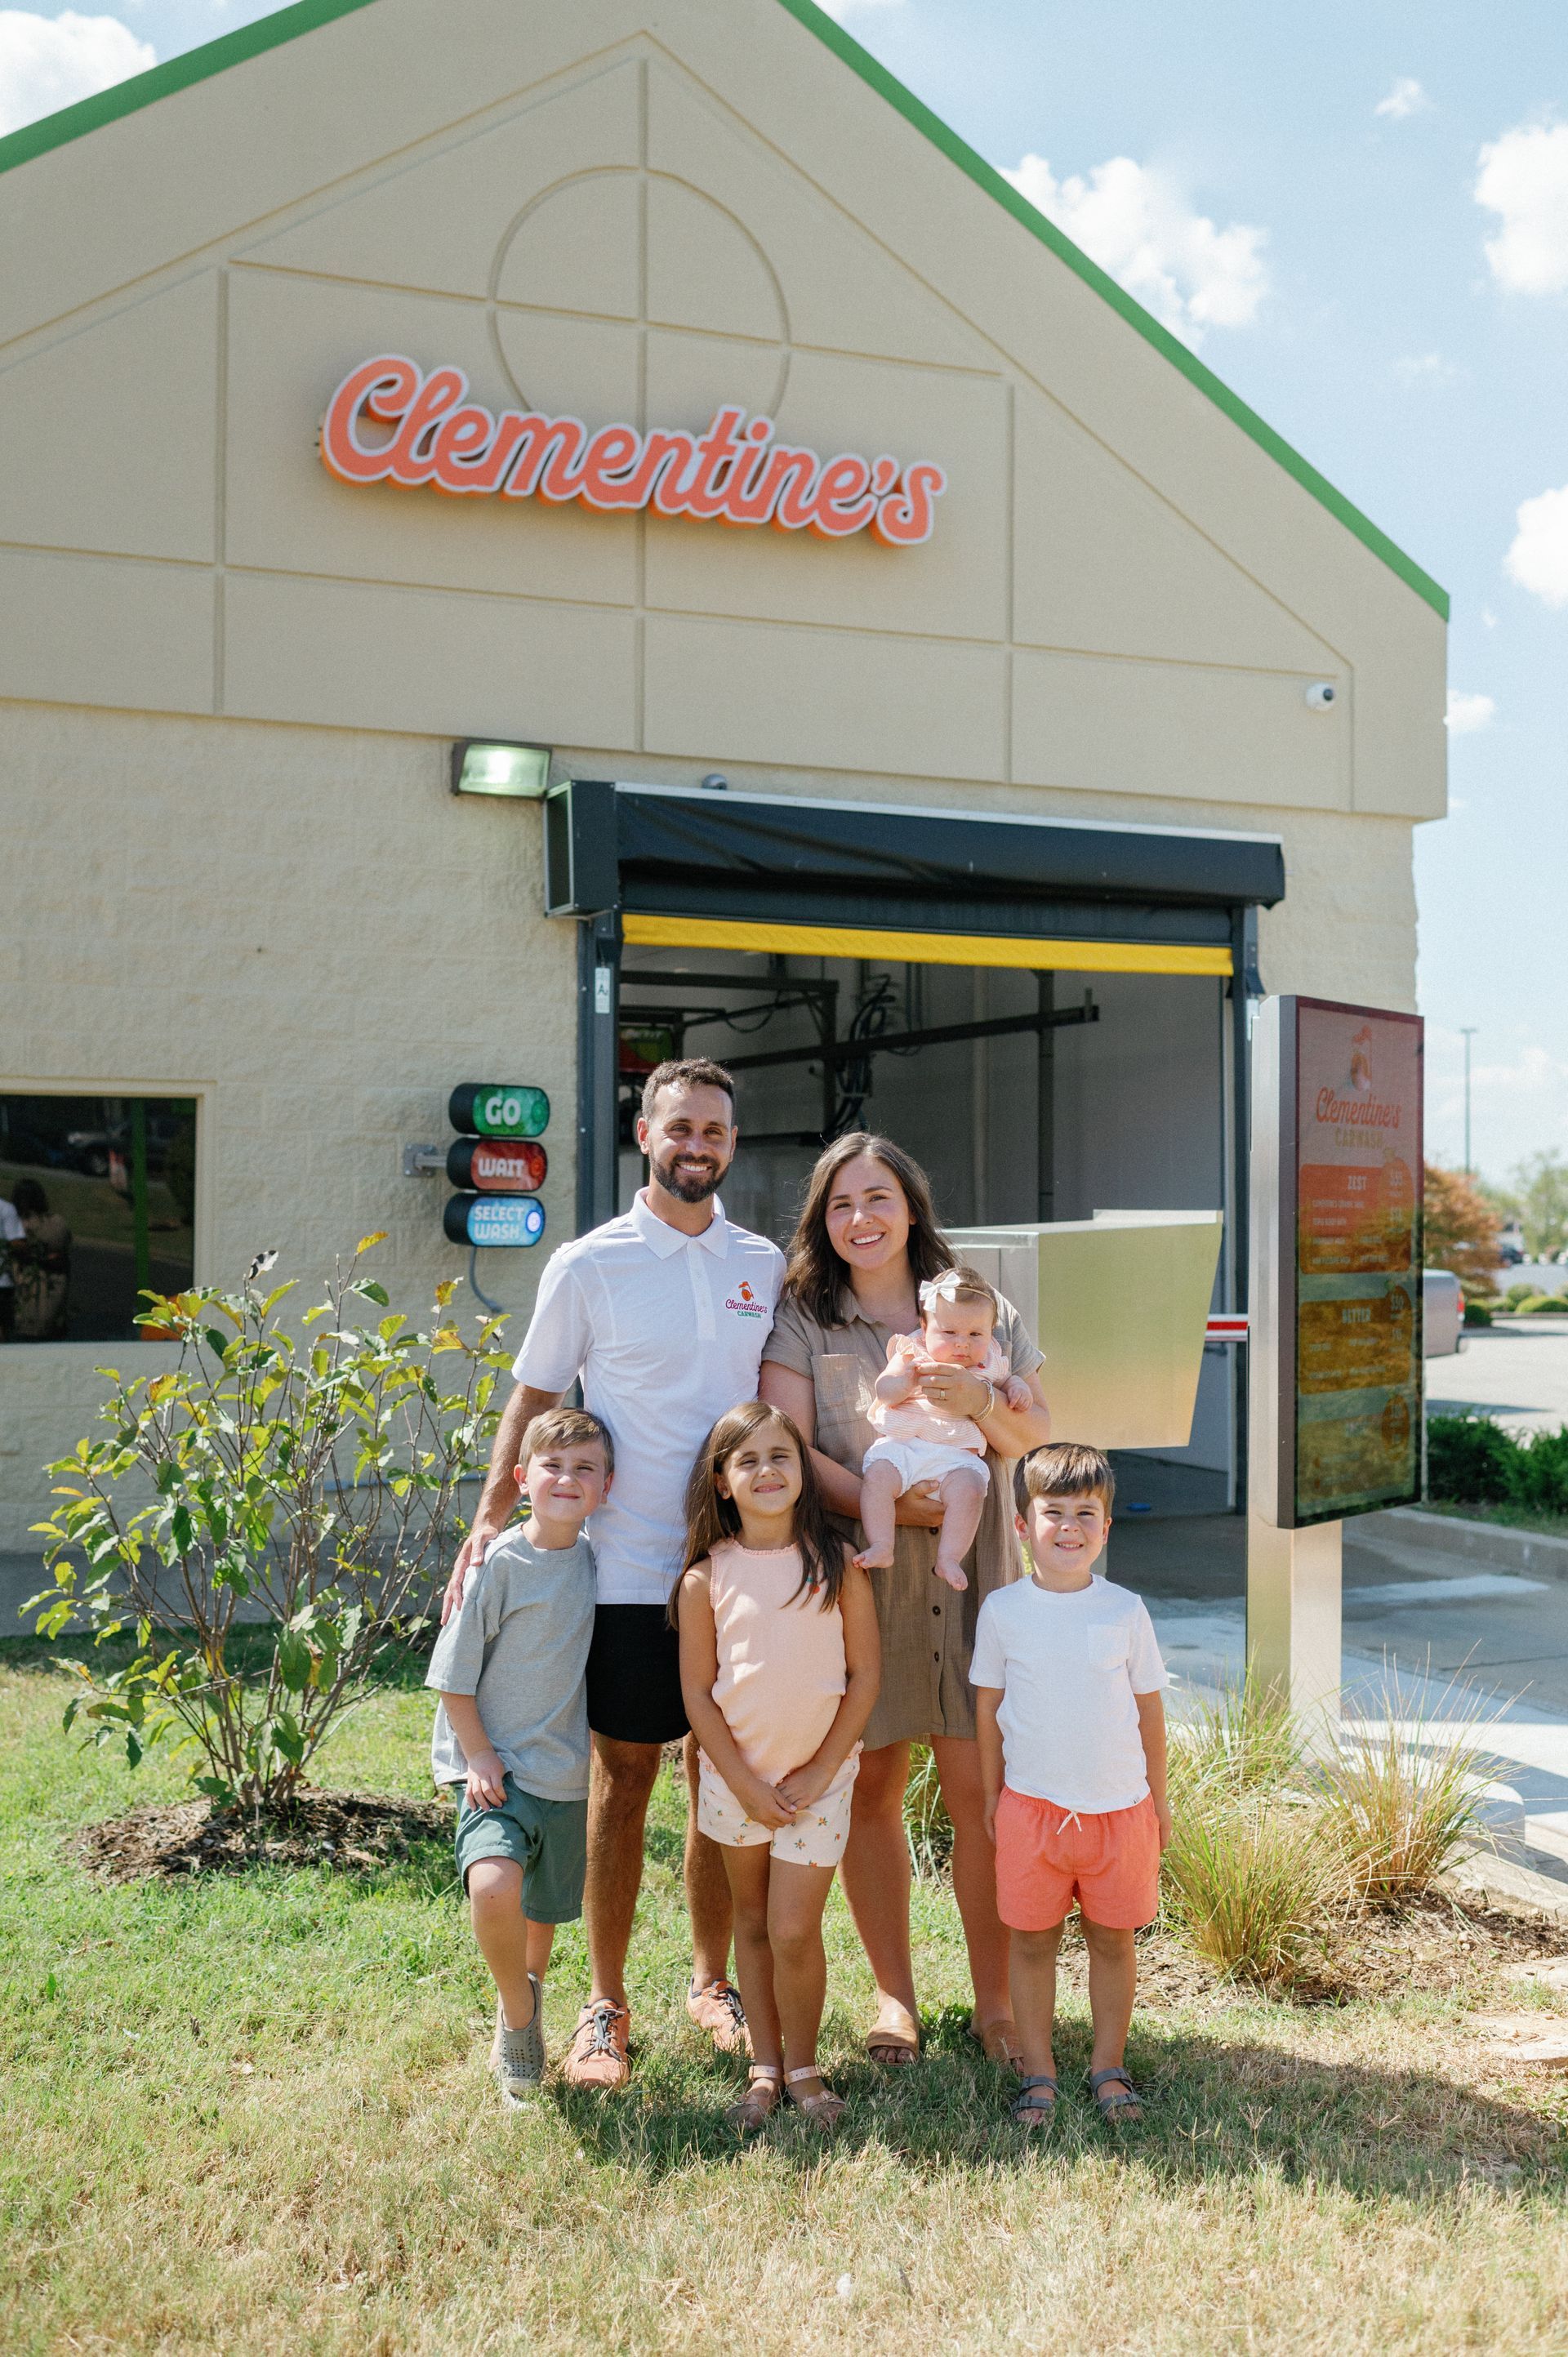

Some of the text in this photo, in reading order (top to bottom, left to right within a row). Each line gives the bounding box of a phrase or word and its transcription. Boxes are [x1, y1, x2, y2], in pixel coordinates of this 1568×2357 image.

[323, 354, 946, 547] Clementine's
[485, 1097, 521, 1125] GO
[1316, 1086, 1401, 1128] Clementine's
[1334, 1126, 1384, 1149] CARWASH
[479, 1159, 524, 1177] WAIT
[474, 1205, 524, 1220] SELECT
[474, 1224, 520, 1239] WASH
[725, 1299, 768, 1313] Clementine's
